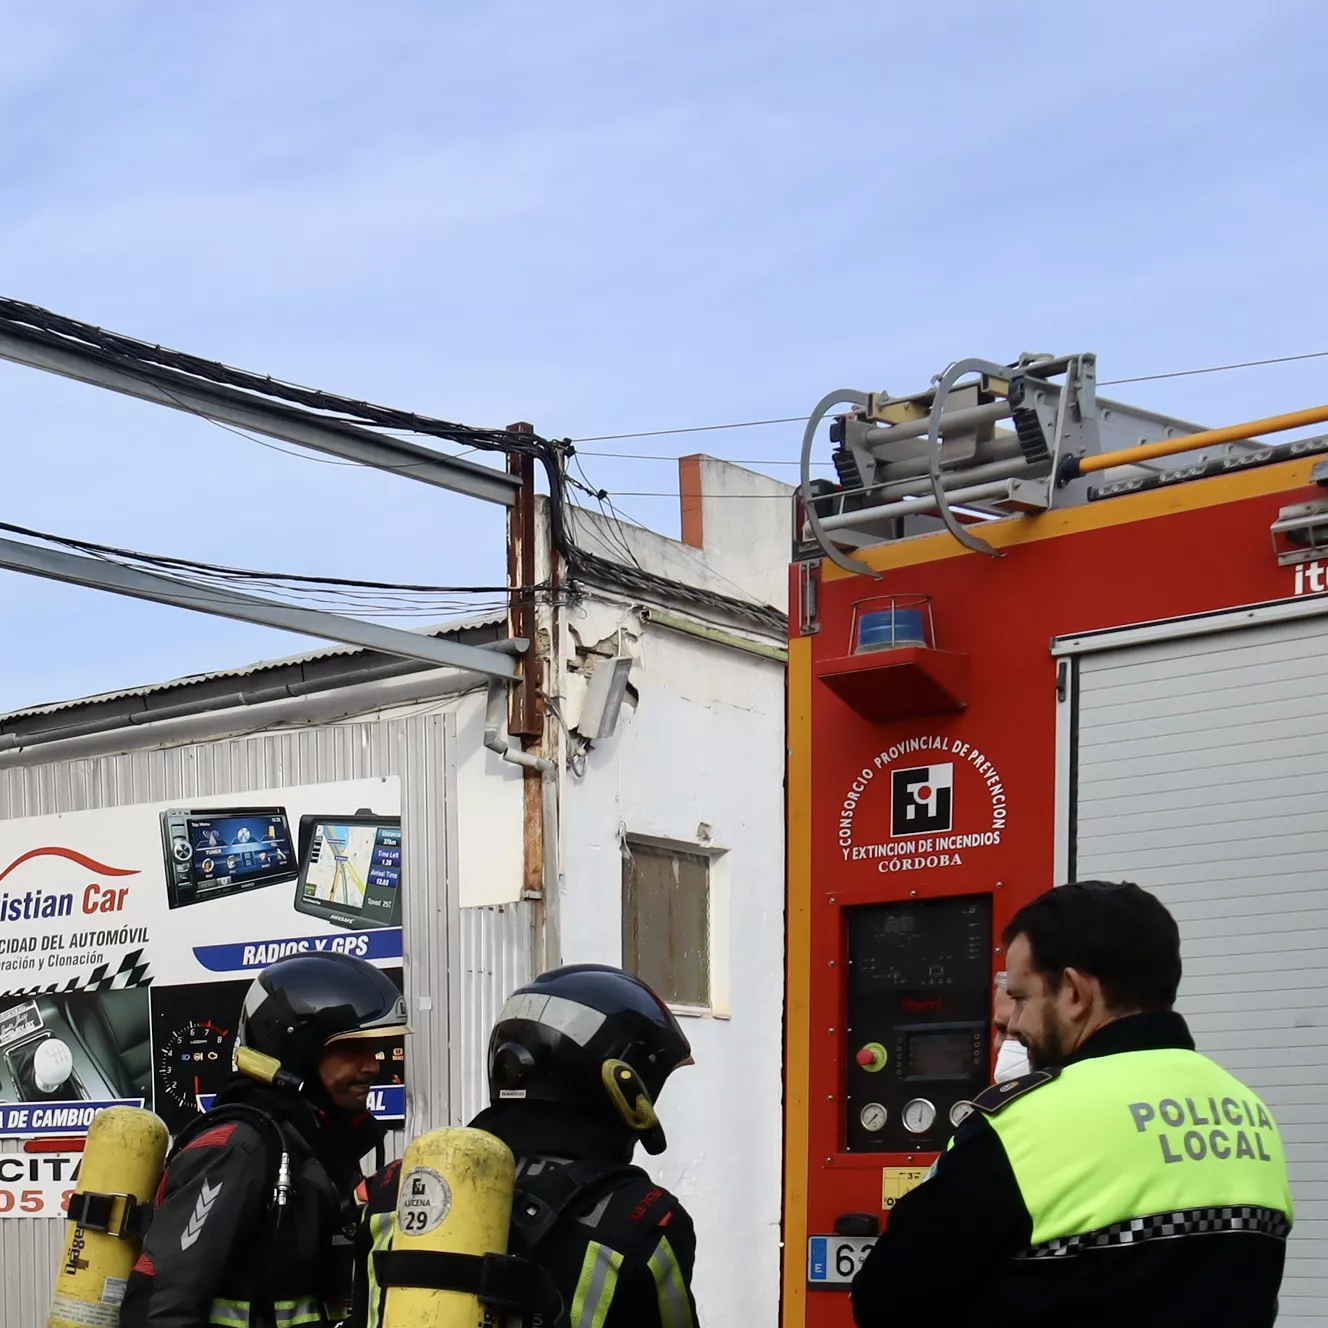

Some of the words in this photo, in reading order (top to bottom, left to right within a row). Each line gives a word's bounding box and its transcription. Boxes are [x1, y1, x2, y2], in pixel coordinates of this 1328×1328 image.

[1294, 561, 1328, 596] it
[838, 767, 874, 847] CONSORCIO
[873, 735, 949, 769] PROVINCIAL
[951, 739, 970, 758] DE
[967, 749, 1007, 829] PREVENCION
[842, 848, 850, 861] Y
[852, 841, 916, 861] EXTINCION
[918, 839, 933, 852] DE
[935, 830, 1001, 851] INCENDIOS
[877, 853, 963, 873] CÓRDOBA
[82, 883, 129, 915] Car
[40, 934, 65, 951] DEL
[69, 924, 150, 949] AUTOMÓVIL
[242, 940, 310, 966] RADIOS
[331, 935, 370, 956] GPS
[37, 957, 44, 971] y
[47, 951, 104, 968] Clonación
[177, 1036, 183, 1044] 5
[189, 1028, 195, 1036] 6
[204, 1028, 210, 1036] 7
[216, 1036, 223, 1044] 8
[167, 1049, 173, 1057] 4
[166, 1066, 172, 1074] 3
[172, 1081, 178, 1089] 2
[7, 1109, 29, 1128] DE
[1127, 1096, 1274, 1133] POLICIA
[1158, 1129, 1272, 1164] LOCAL
[907, 1172, 913, 1180] 3
[404, 1199, 431, 1207] LUCENA
[405, 1210, 428, 1231] 29
[814, 1263, 823, 1273] E
